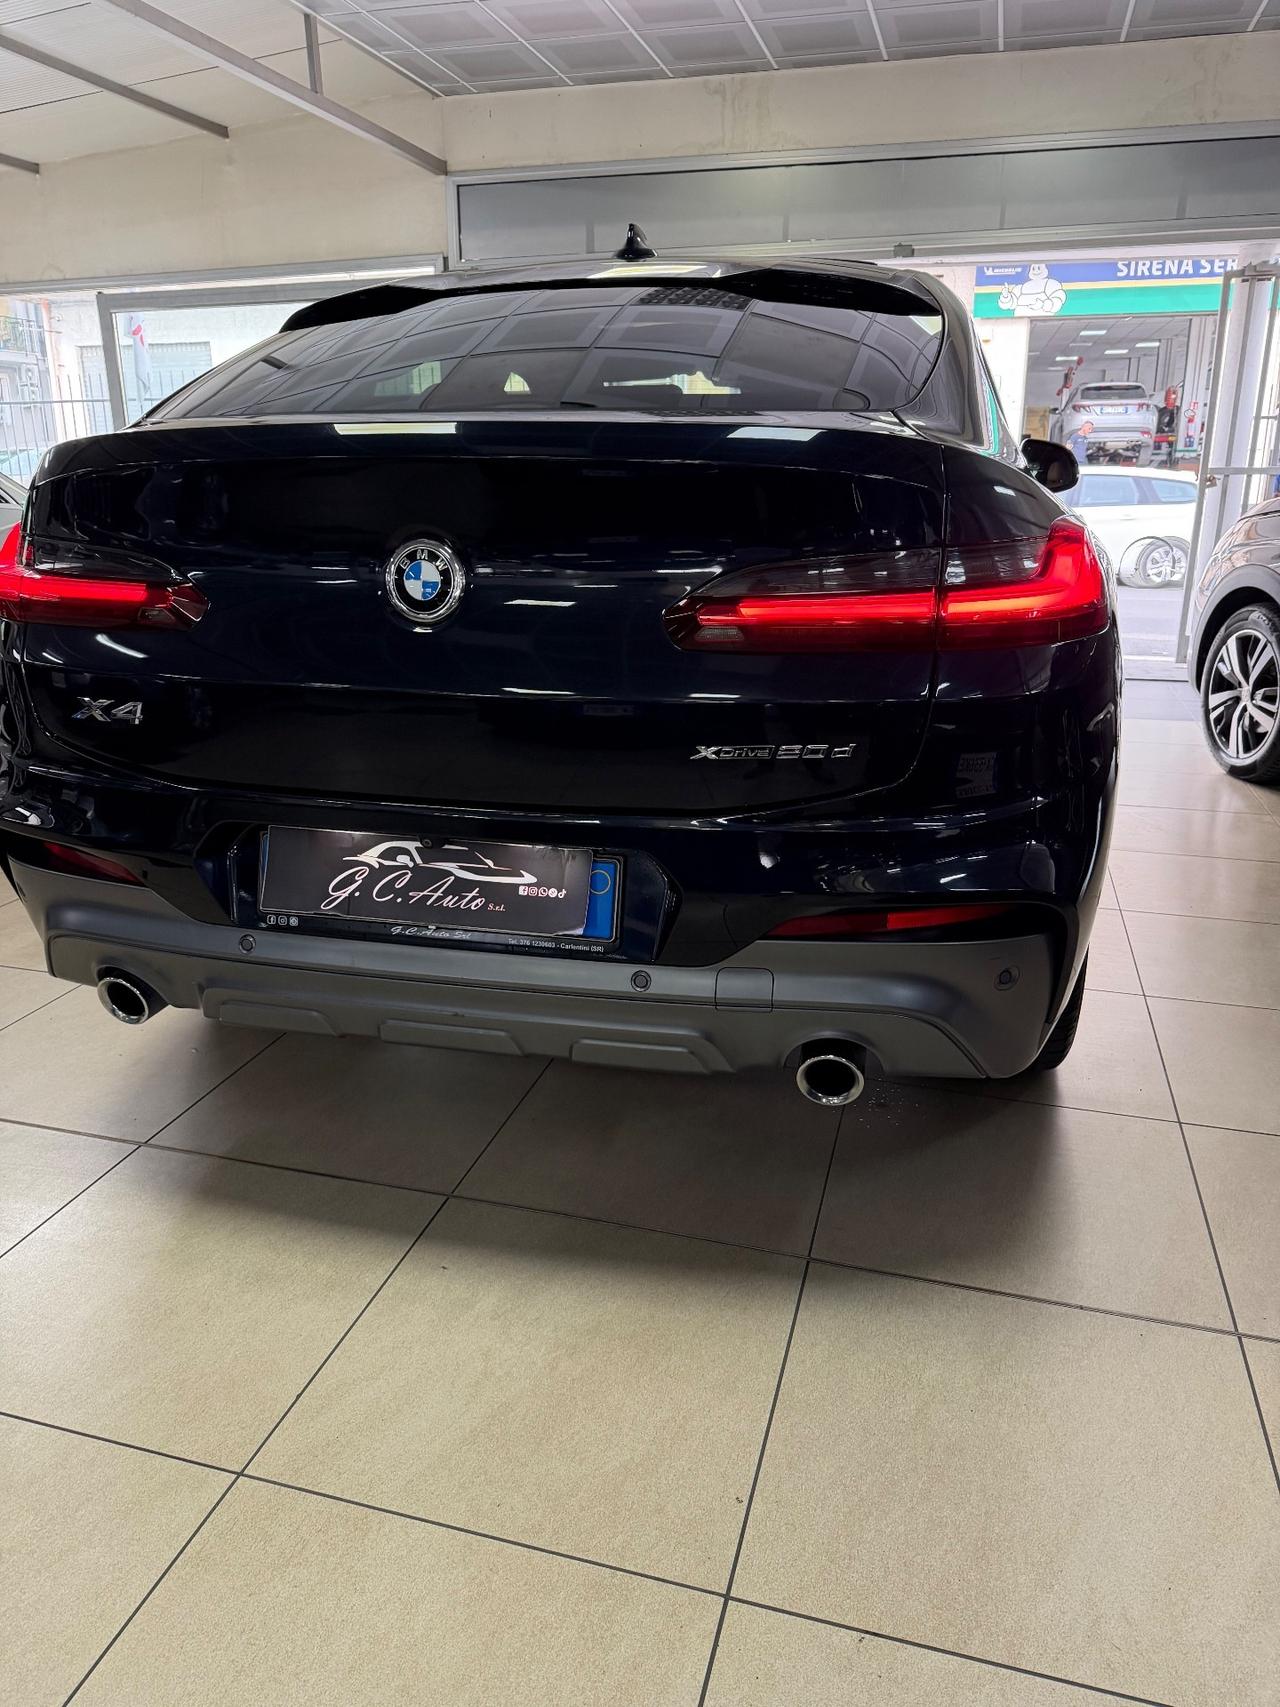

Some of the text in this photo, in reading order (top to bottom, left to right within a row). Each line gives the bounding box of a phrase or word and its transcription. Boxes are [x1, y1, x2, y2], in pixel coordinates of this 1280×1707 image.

[1116, 259, 1193, 277] SIRENA
[398, 549, 448, 571] BMW
[72, 696, 143, 725] X4
[408, 875, 486, 910] Auto
